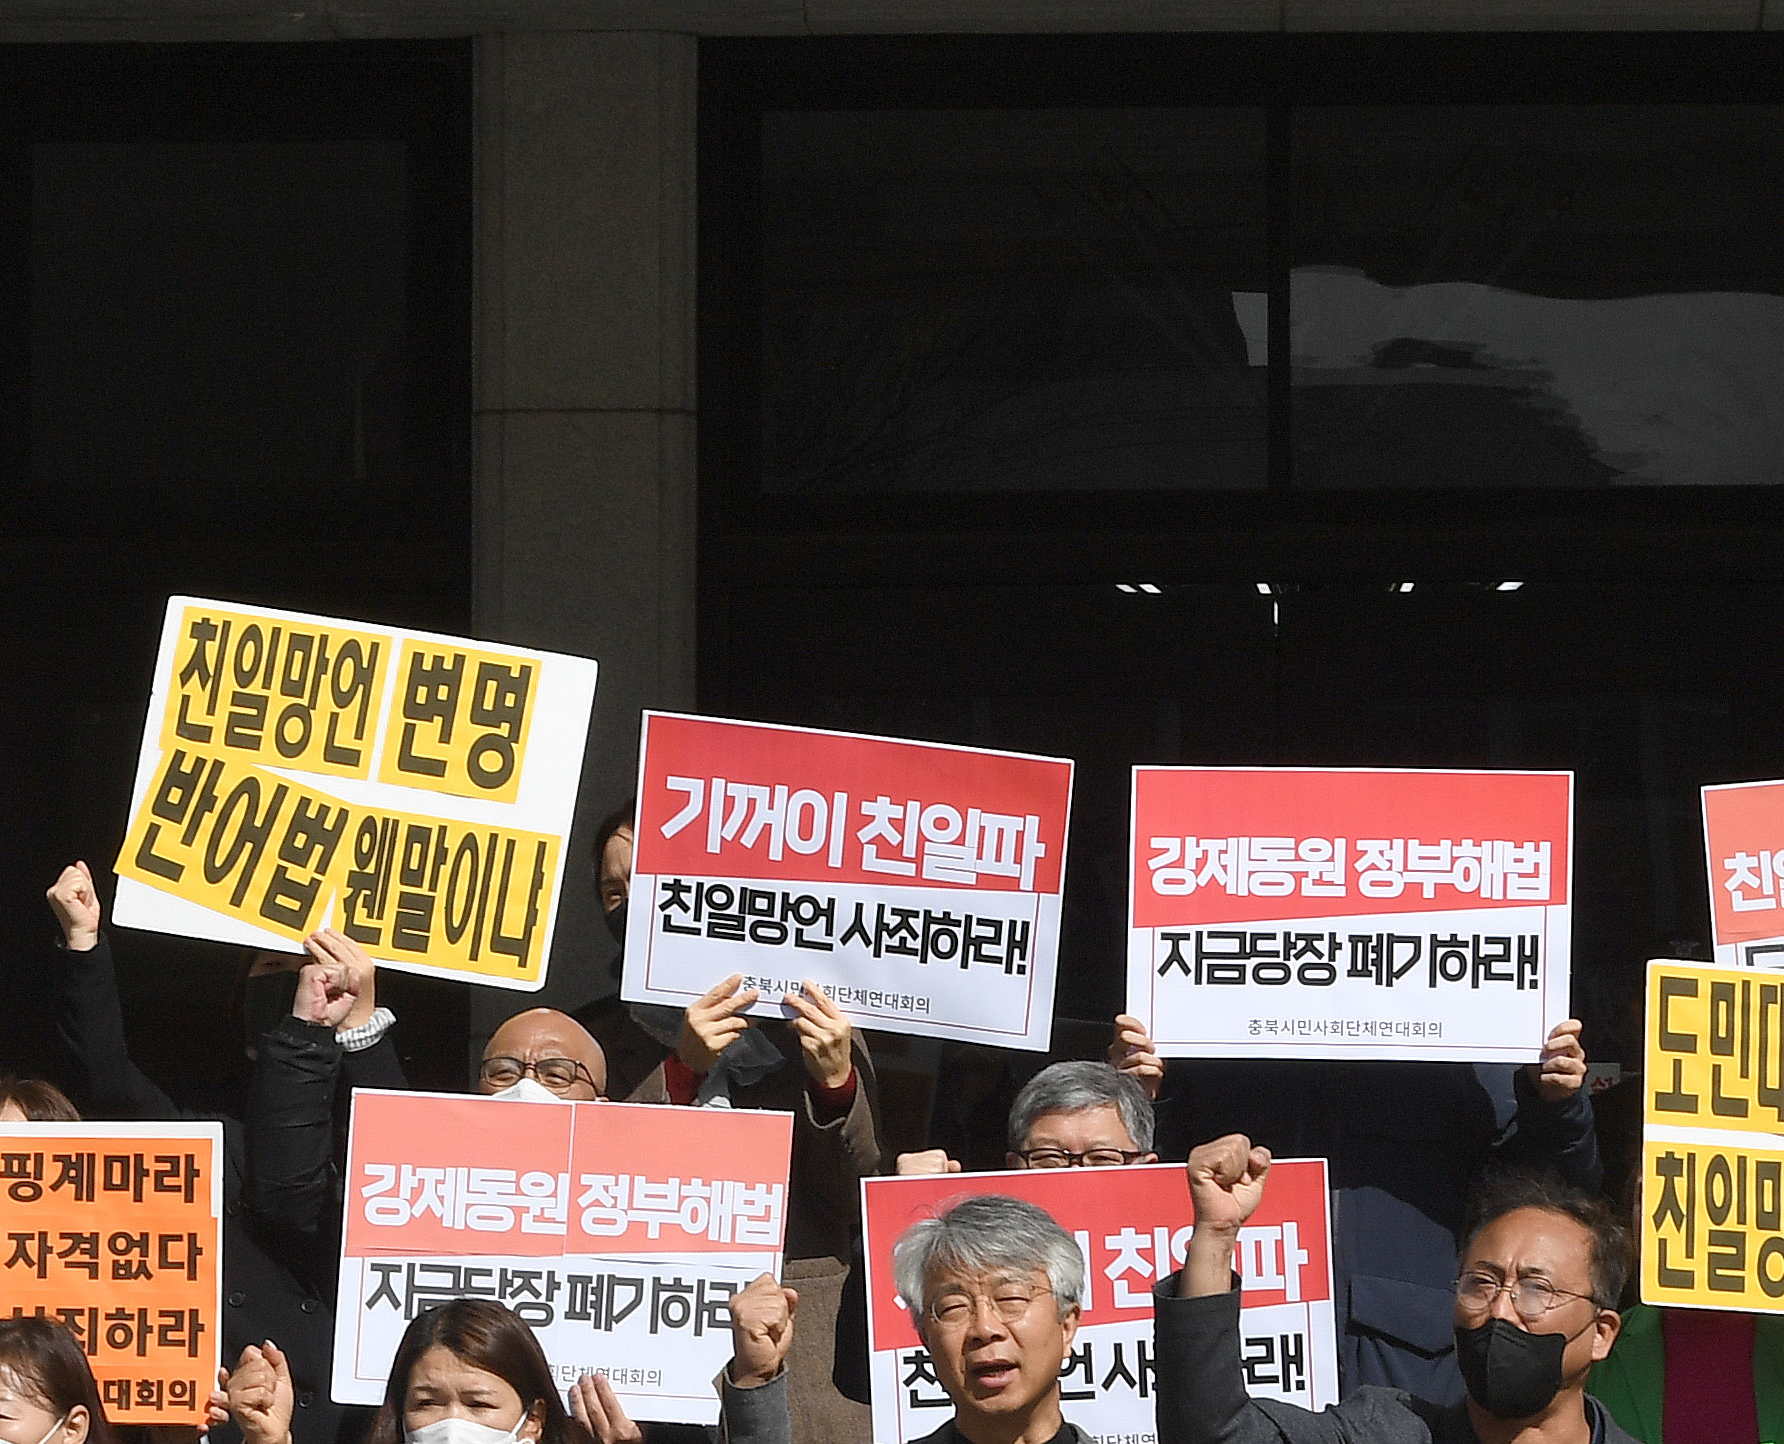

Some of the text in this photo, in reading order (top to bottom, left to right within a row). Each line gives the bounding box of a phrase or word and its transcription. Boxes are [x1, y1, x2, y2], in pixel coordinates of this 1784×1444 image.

[176, 617, 533, 789] 친일망언 변명
[134, 748, 547, 968] 반어법 웬말이냐
[660, 776, 1046, 891] 기꺼이 친일파
[1147, 836, 1552, 901] 강제동원 정부해법
[657, 879, 1031, 976] 친일망언 사죄하라!
[1158, 930, 1539, 990] 지금당장 폐기하라!
[741, 975, 932, 1015] 충북시민회단체연대회의
[1247, 1018, 1444, 1039] 충북시민사회단체연대회의
[0, 1152, 201, 1204] 핑계마라
[360, 1164, 784, 1245] 강제동원 정부해법
[4, 1230, 204, 1282] 자격없다
